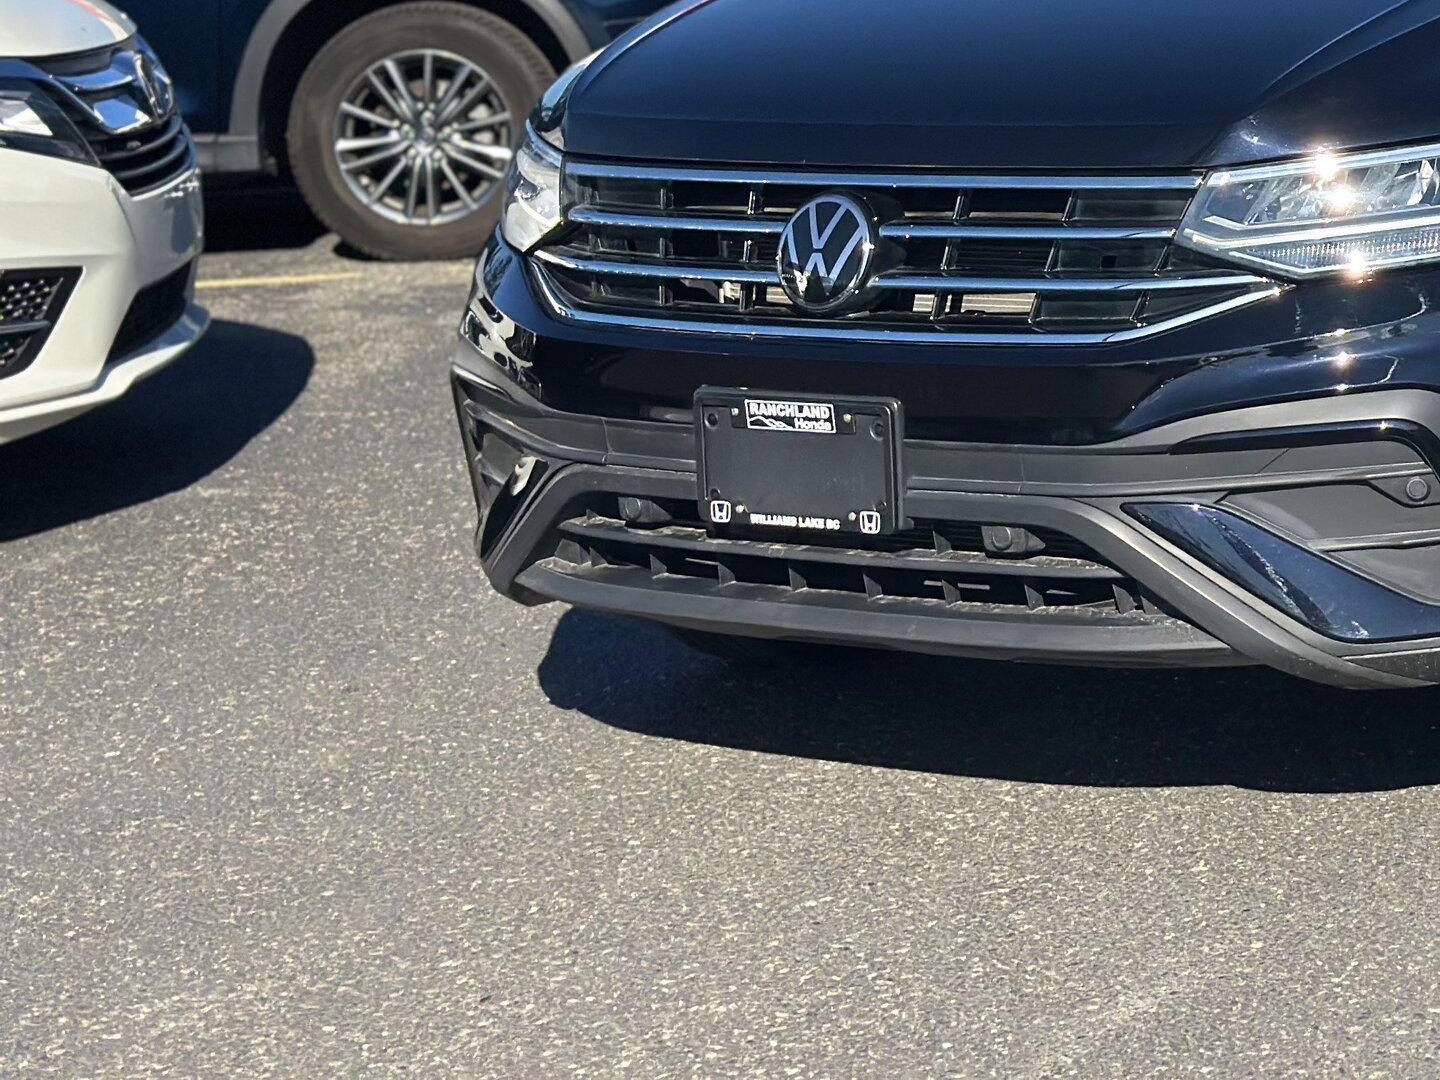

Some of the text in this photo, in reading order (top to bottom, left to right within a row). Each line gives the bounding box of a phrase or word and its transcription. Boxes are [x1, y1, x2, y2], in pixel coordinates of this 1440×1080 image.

[749, 402, 830, 419] RANCHLAND
[794, 417, 832, 431] Honda
[750, 513, 841, 531] WILLIAMS LAKE BC
